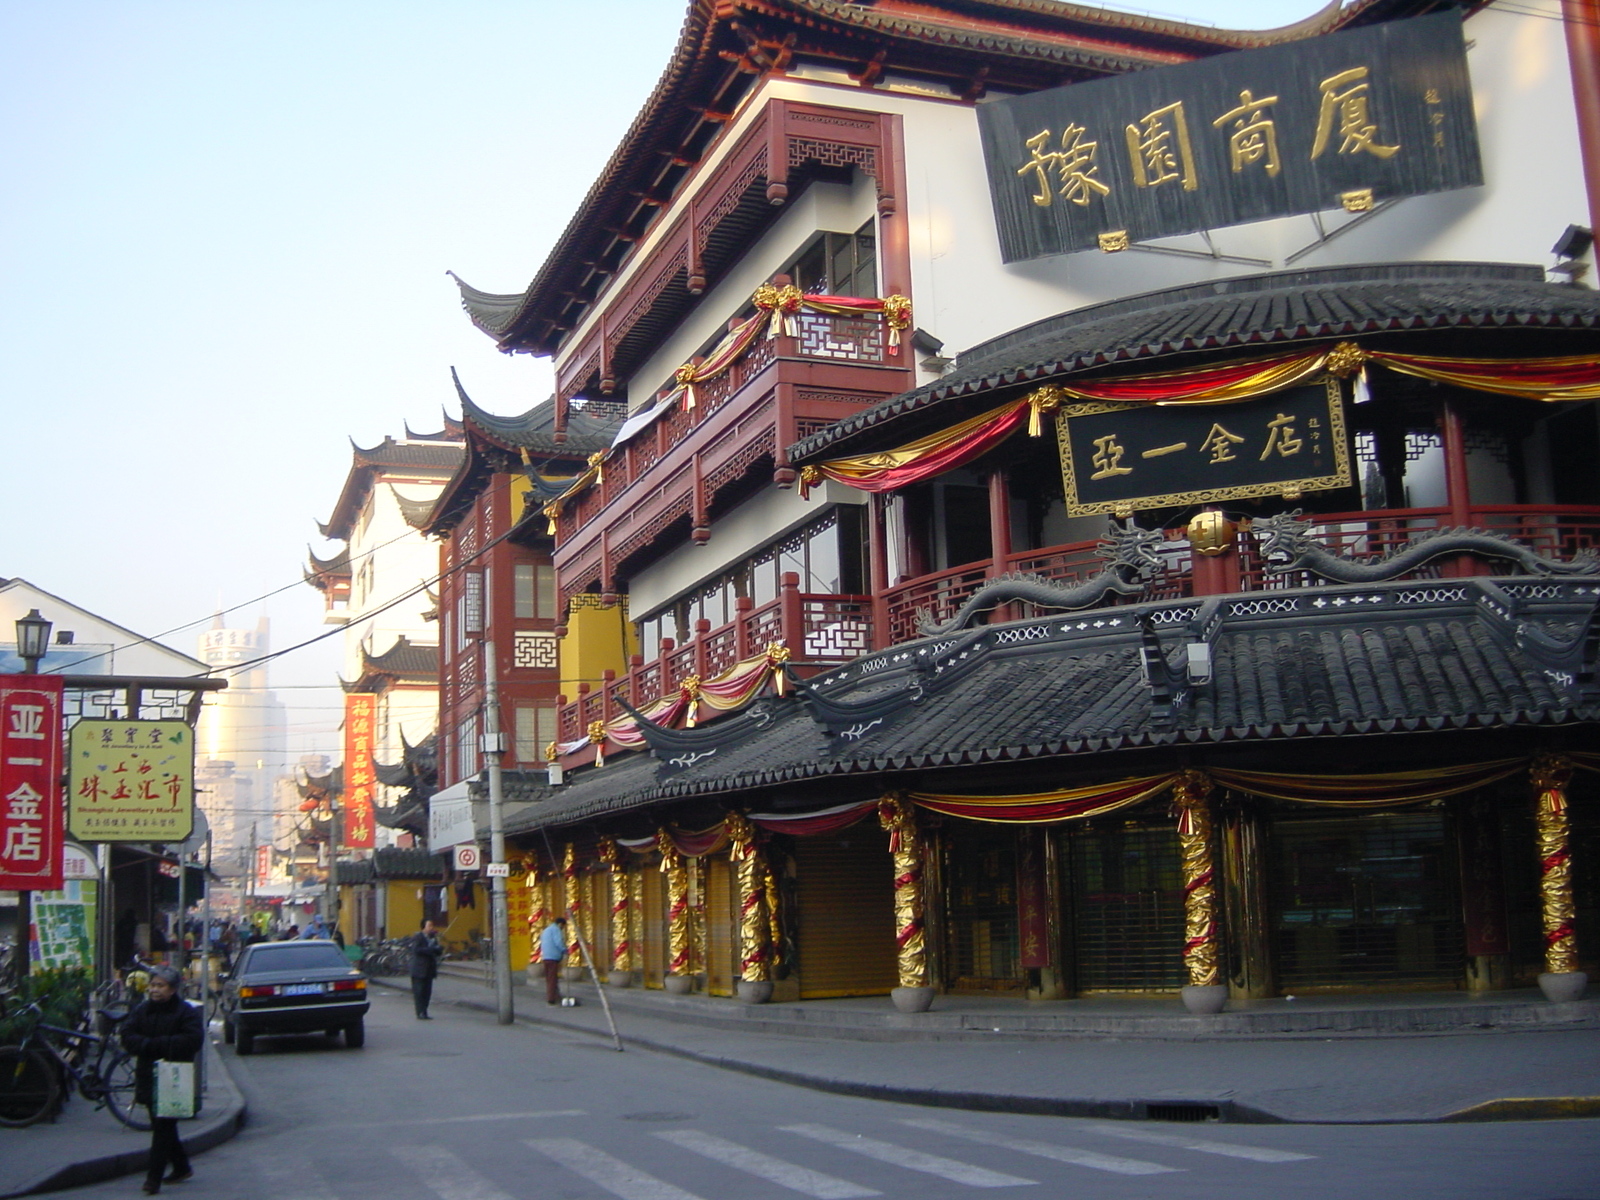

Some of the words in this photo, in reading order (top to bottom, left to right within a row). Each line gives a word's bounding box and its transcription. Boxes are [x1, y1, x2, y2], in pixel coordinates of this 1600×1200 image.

[2, 704, 45, 862] 亚一金店
[112, 759, 153, 774] 上海
